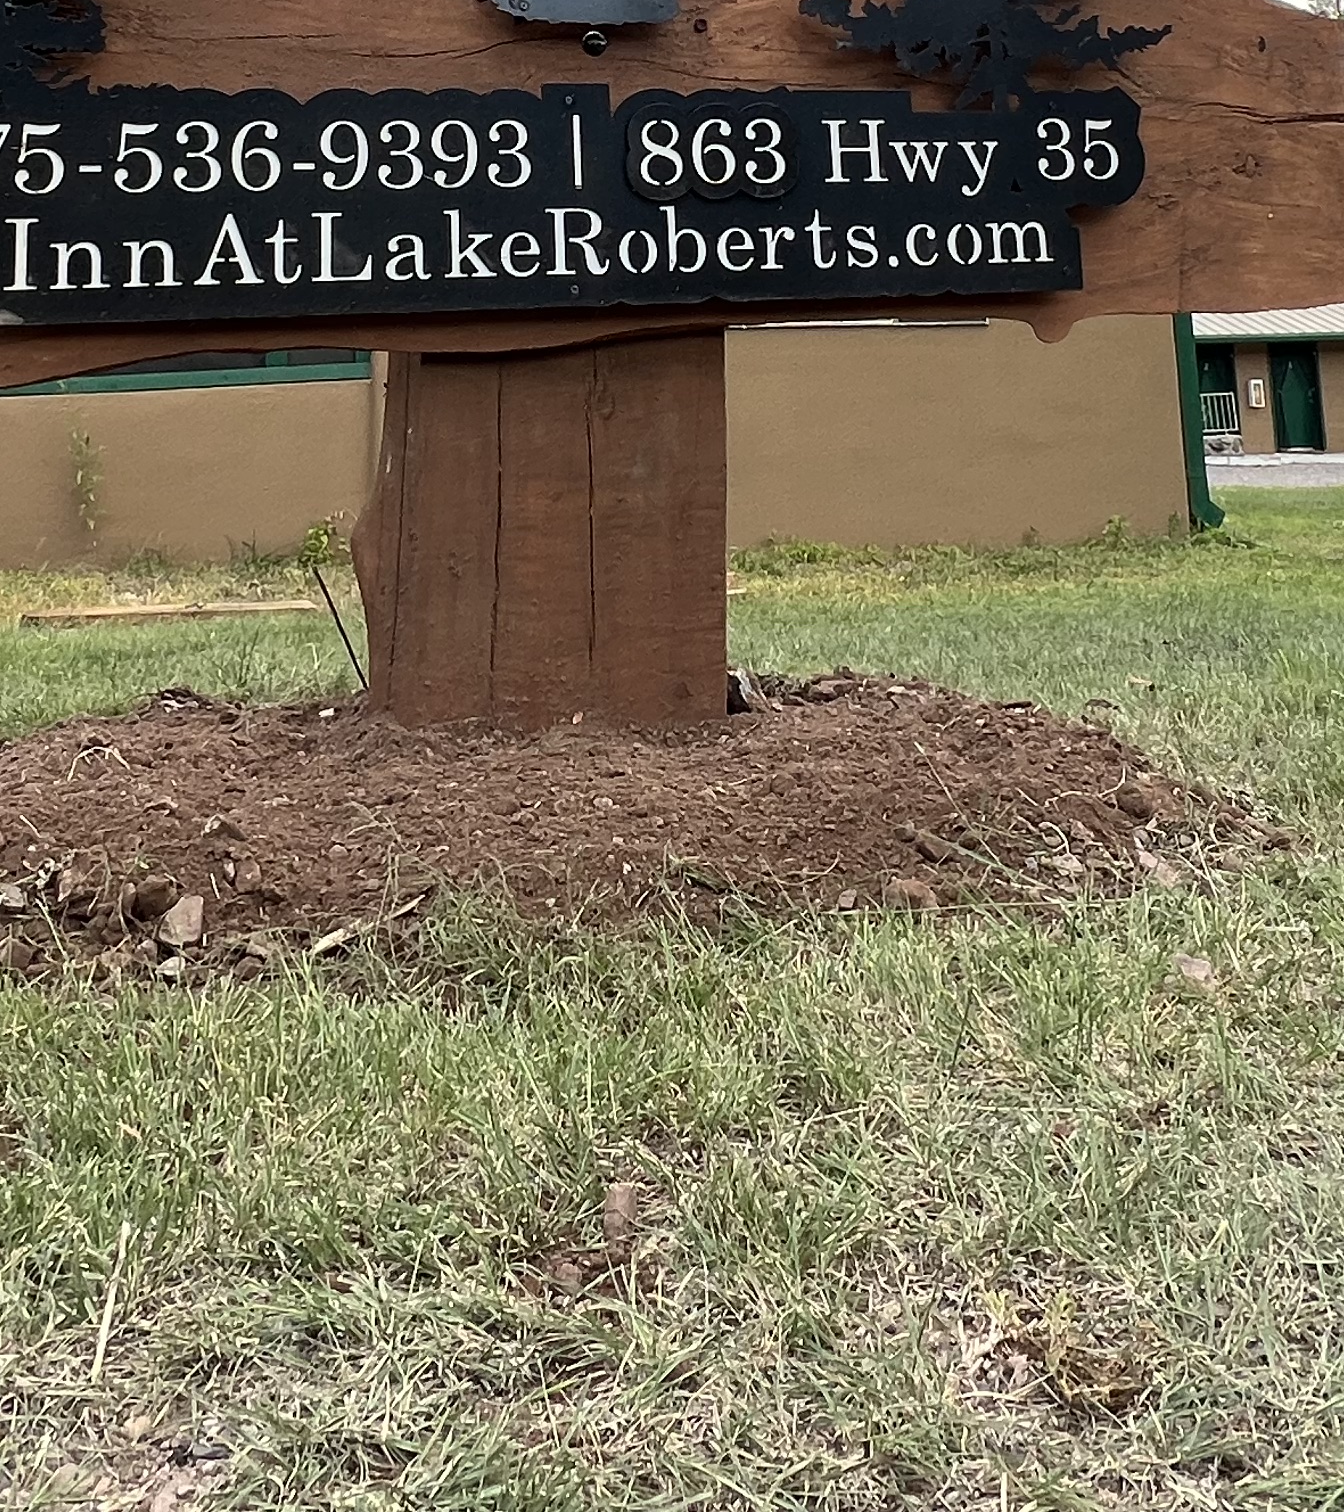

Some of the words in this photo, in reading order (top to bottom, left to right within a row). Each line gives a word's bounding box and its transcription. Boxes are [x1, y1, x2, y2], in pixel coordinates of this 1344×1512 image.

[640, 118, 787, 186] 863
[821, 119, 998, 198] Hwy
[1037, 118, 1120, 182] 35
[3, 205, 1055, 292] InnAtLakeRoberts.com
